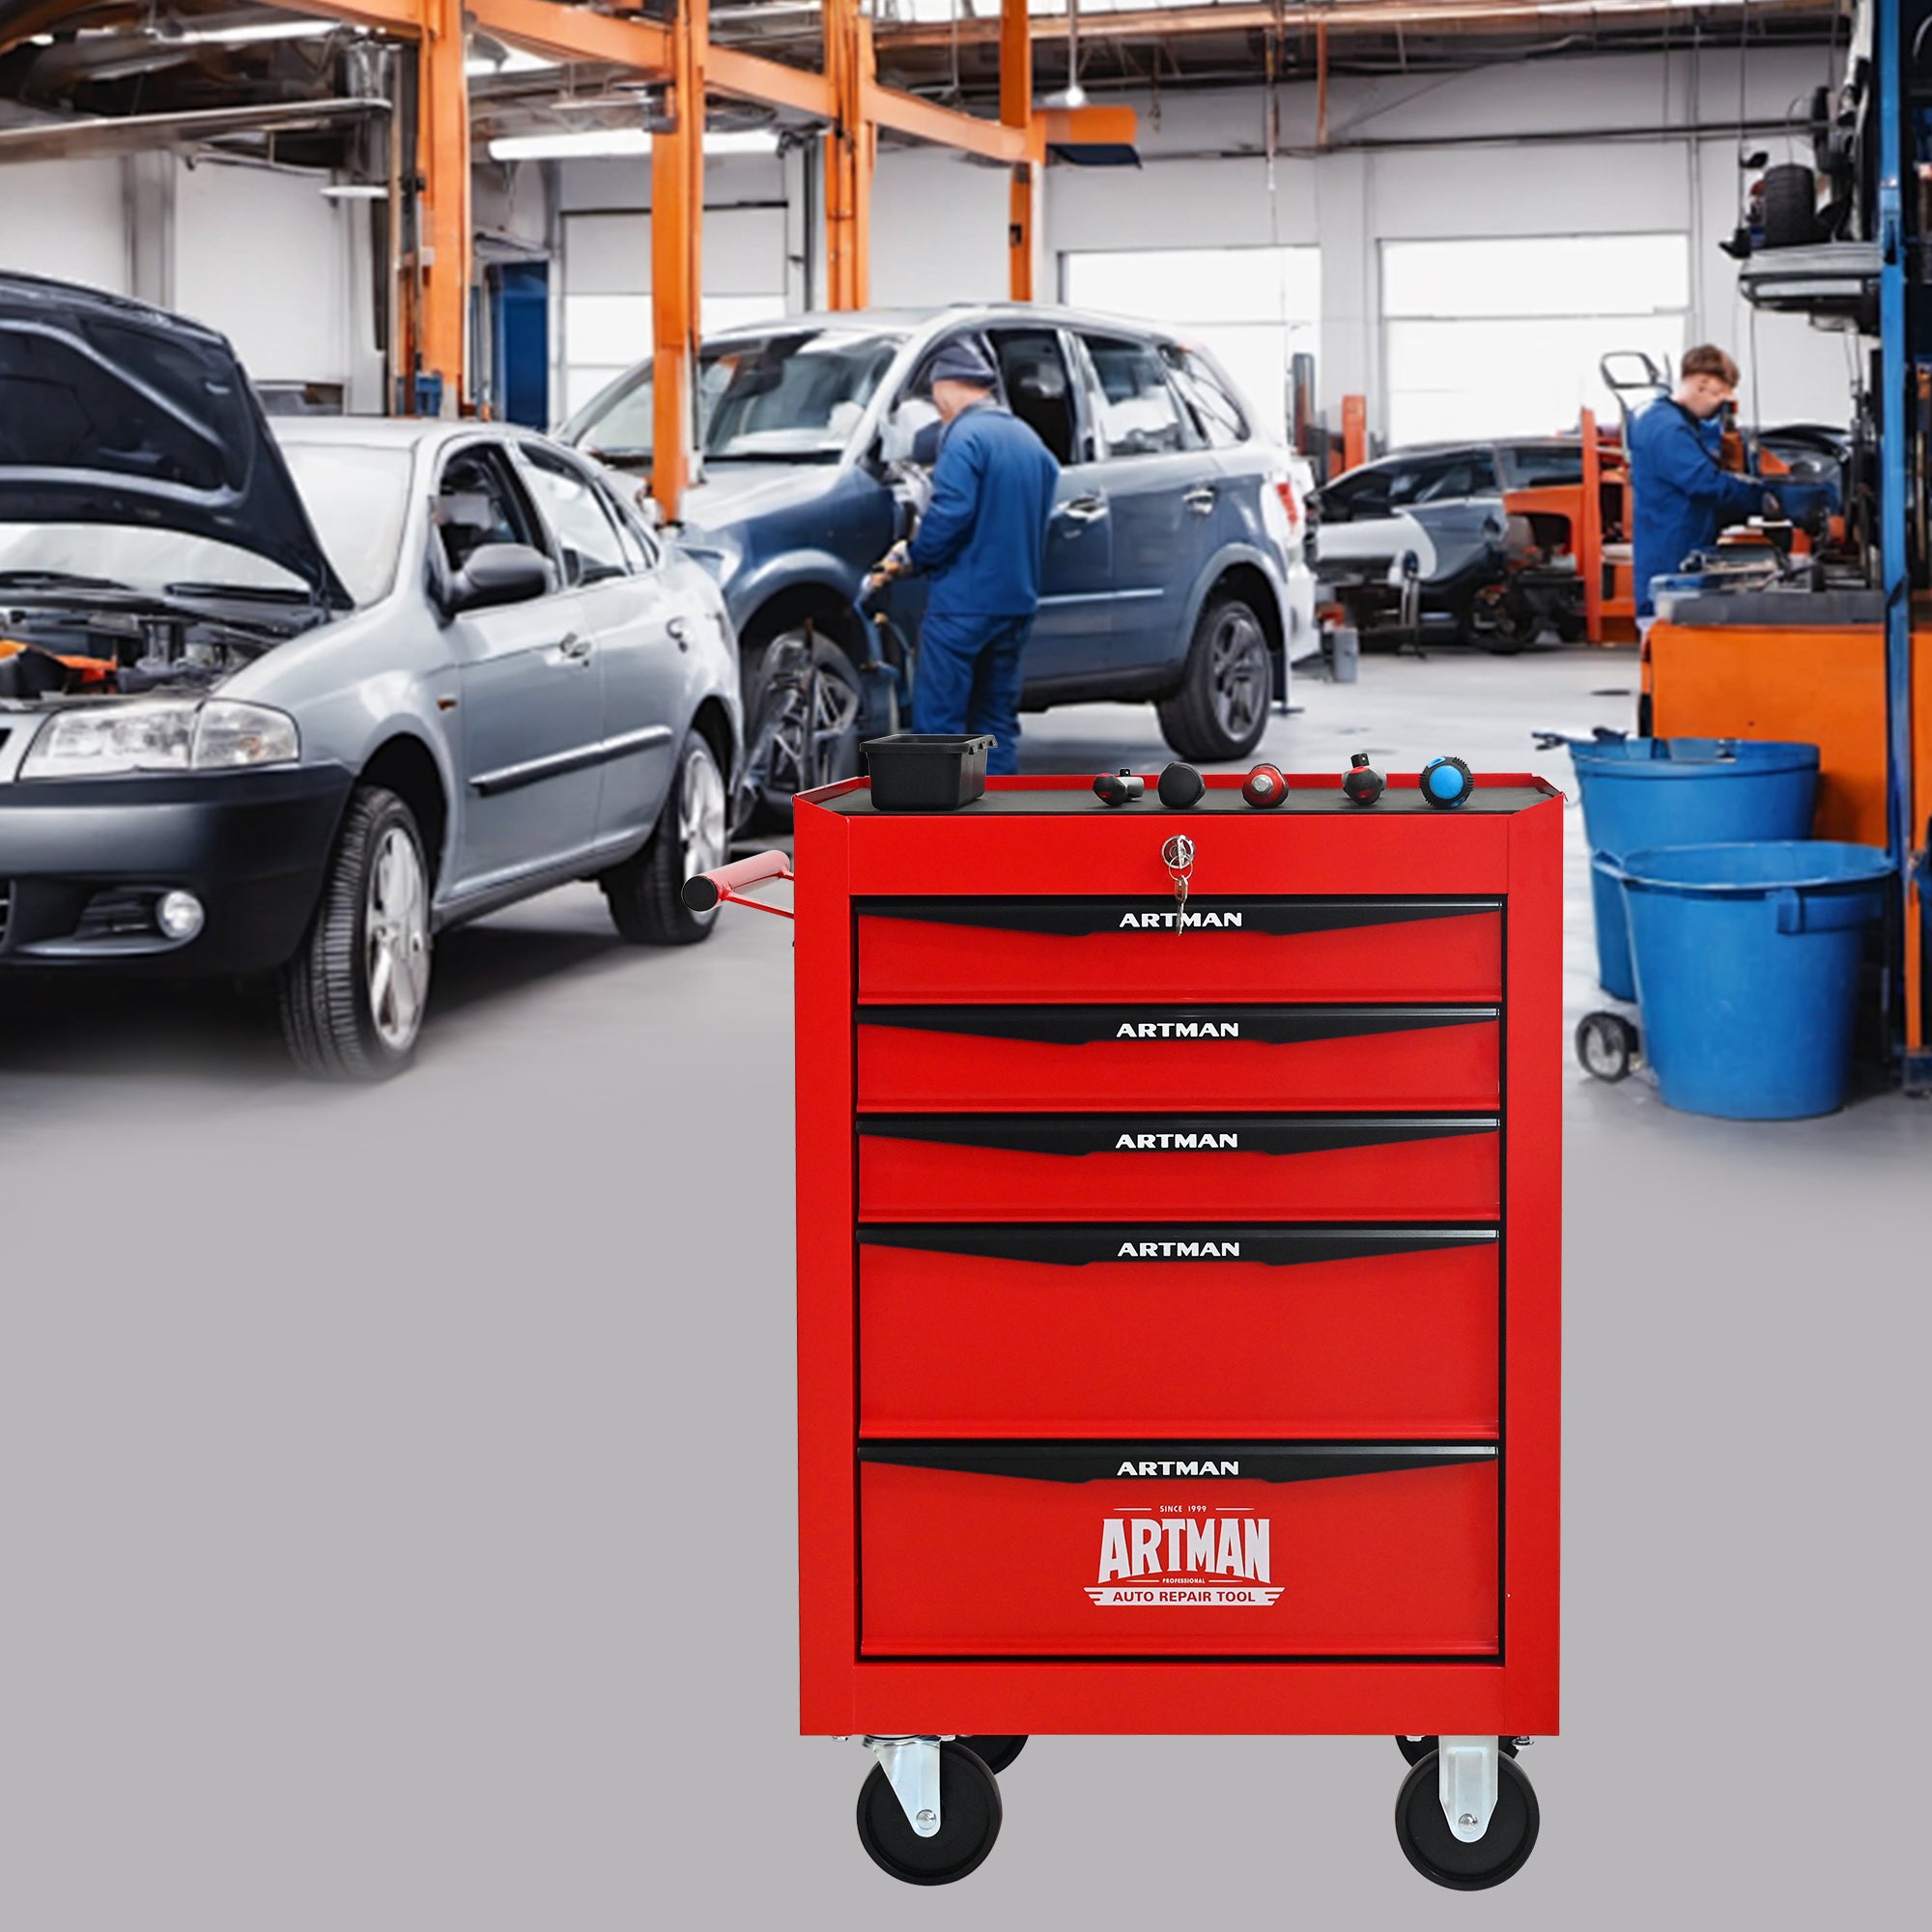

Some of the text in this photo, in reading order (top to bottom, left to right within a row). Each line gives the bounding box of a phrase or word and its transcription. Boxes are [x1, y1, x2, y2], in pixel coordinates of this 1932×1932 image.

[1119, 912, 1242, 927] ARTMAN
[1116, 1022, 1239, 1037] ARTMAN
[1115, 1133, 1238, 1149] ARTMAN
[1117, 1241, 1240, 1257] ARTMAN
[1116, 1461, 1239, 1476] ARTMAN
[1097, 1519, 1271, 1584] ARTMAN
[1113, 1591, 1256, 1603] AUTO REPAIR TOOL
